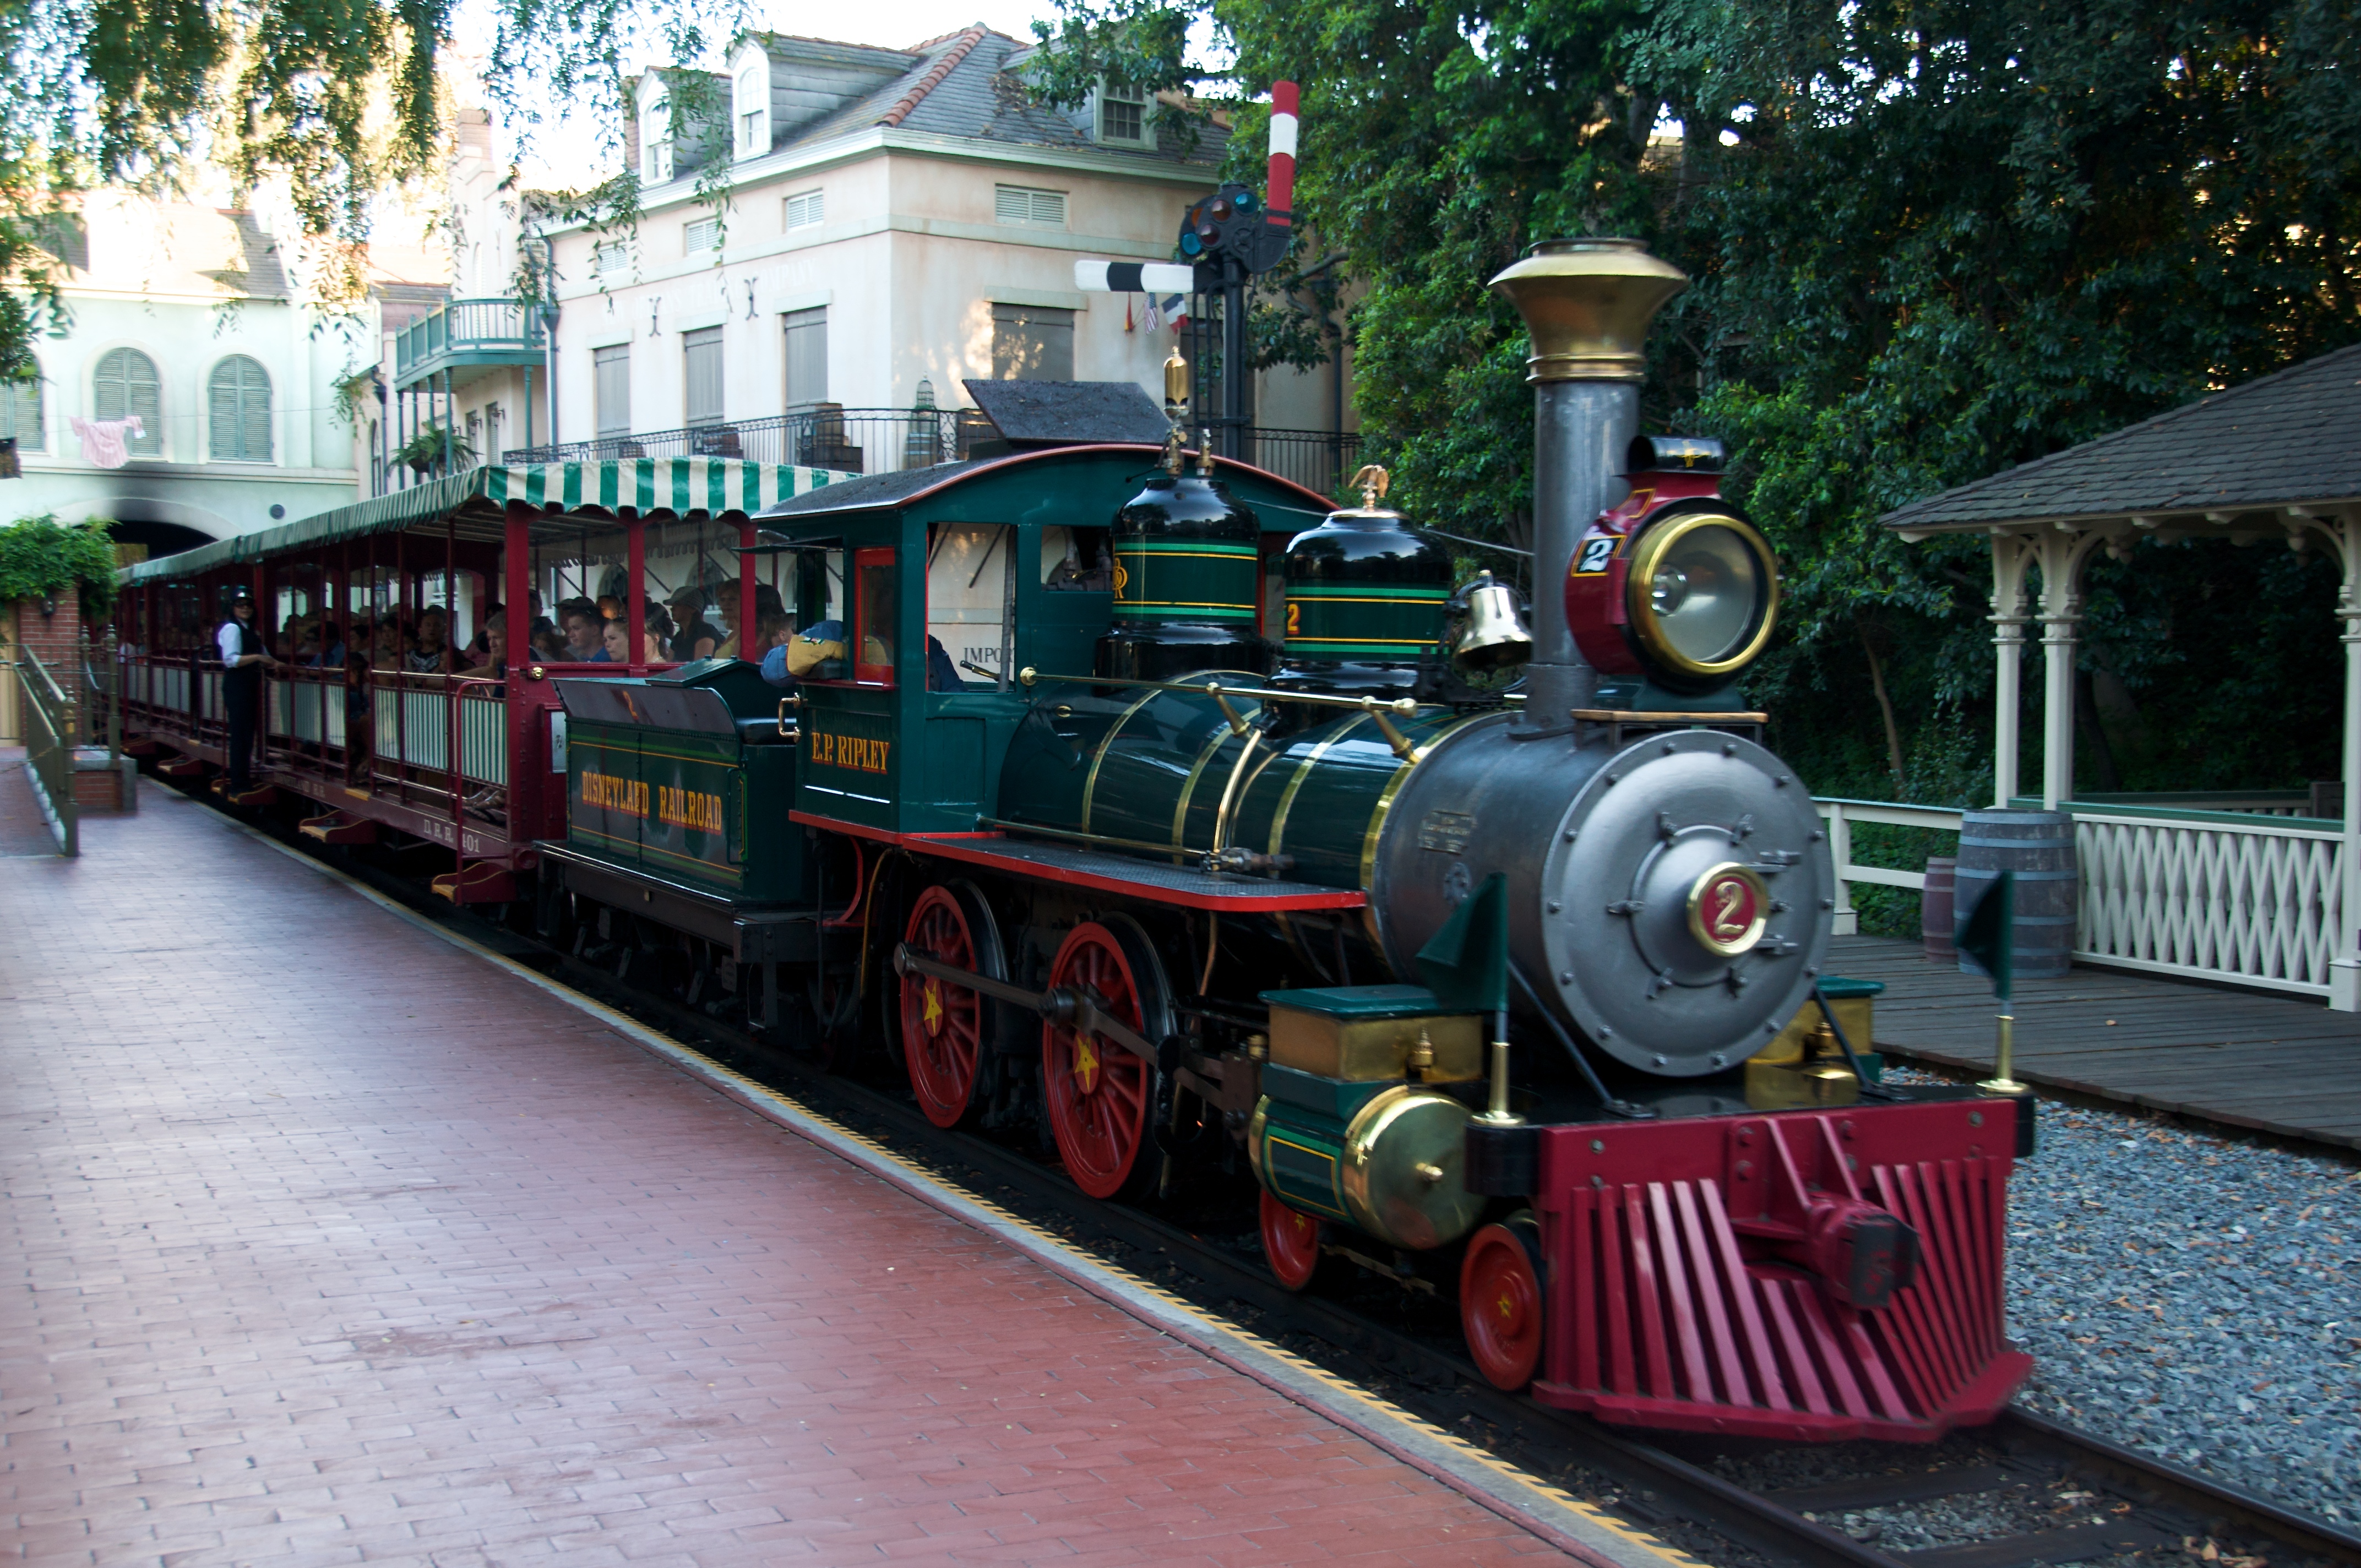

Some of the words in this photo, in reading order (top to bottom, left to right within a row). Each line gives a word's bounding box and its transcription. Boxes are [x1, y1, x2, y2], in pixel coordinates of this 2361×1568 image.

[1579, 540, 1613, 571] 2
[1287, 603, 1300, 634] 2
[837, 736, 890, 773] RIPLEY
[582, 771, 649, 818] DISNEYLAND
[659, 786, 722, 834] RAILROAD
[1714, 881, 1744, 934] 2
